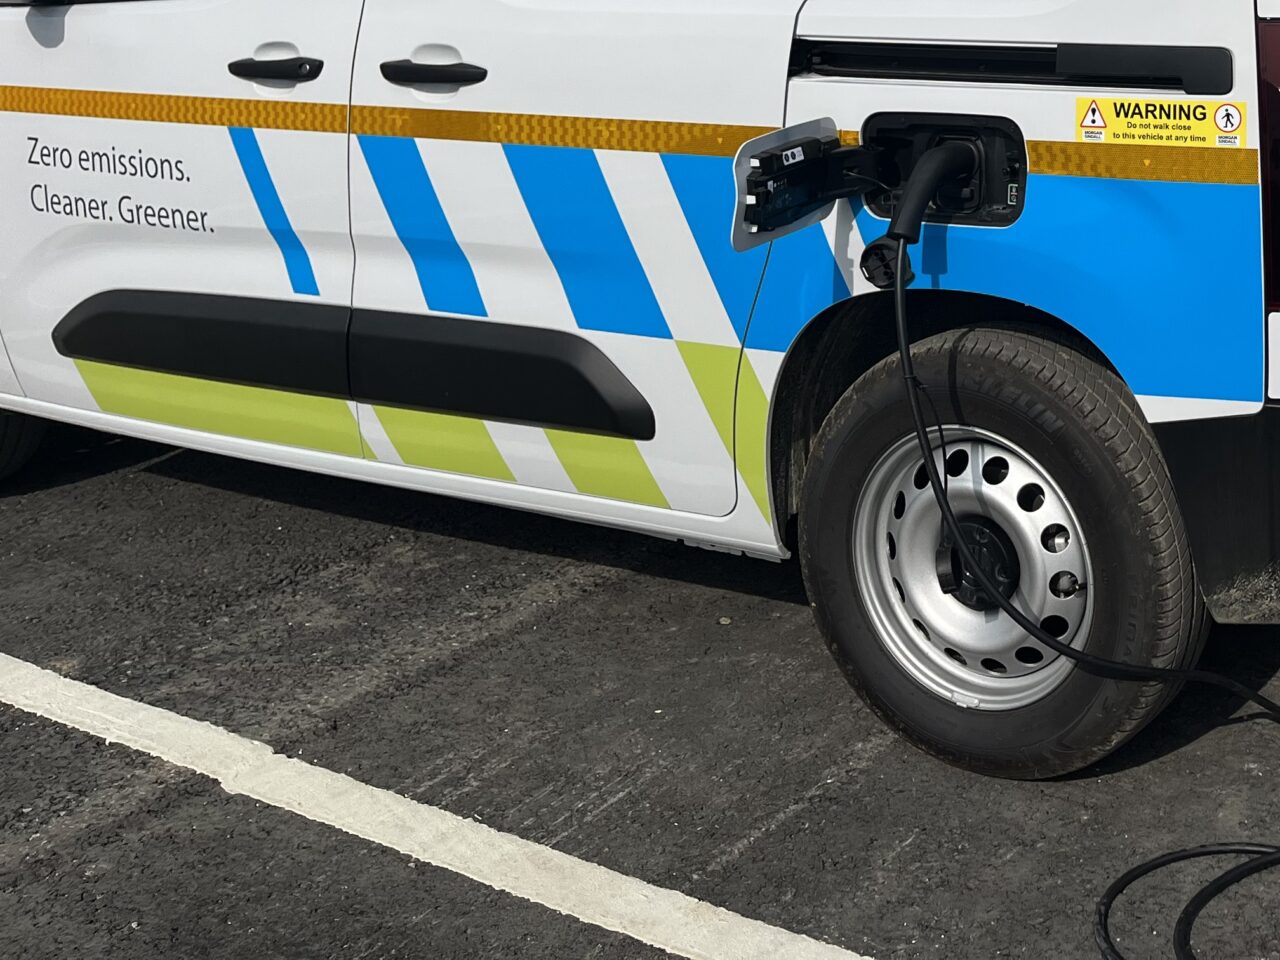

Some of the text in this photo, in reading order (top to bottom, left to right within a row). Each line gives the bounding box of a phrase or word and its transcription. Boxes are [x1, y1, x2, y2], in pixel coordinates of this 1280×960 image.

[1113, 102, 1207, 121] WARNING
[1171, 123, 1191, 131] close
[1122, 132, 1136, 140] this
[1190, 134, 1206, 142] time
[27, 137, 190, 182] Zero emissions.
[31, 184, 215, 233] Cleaner. Greener.
